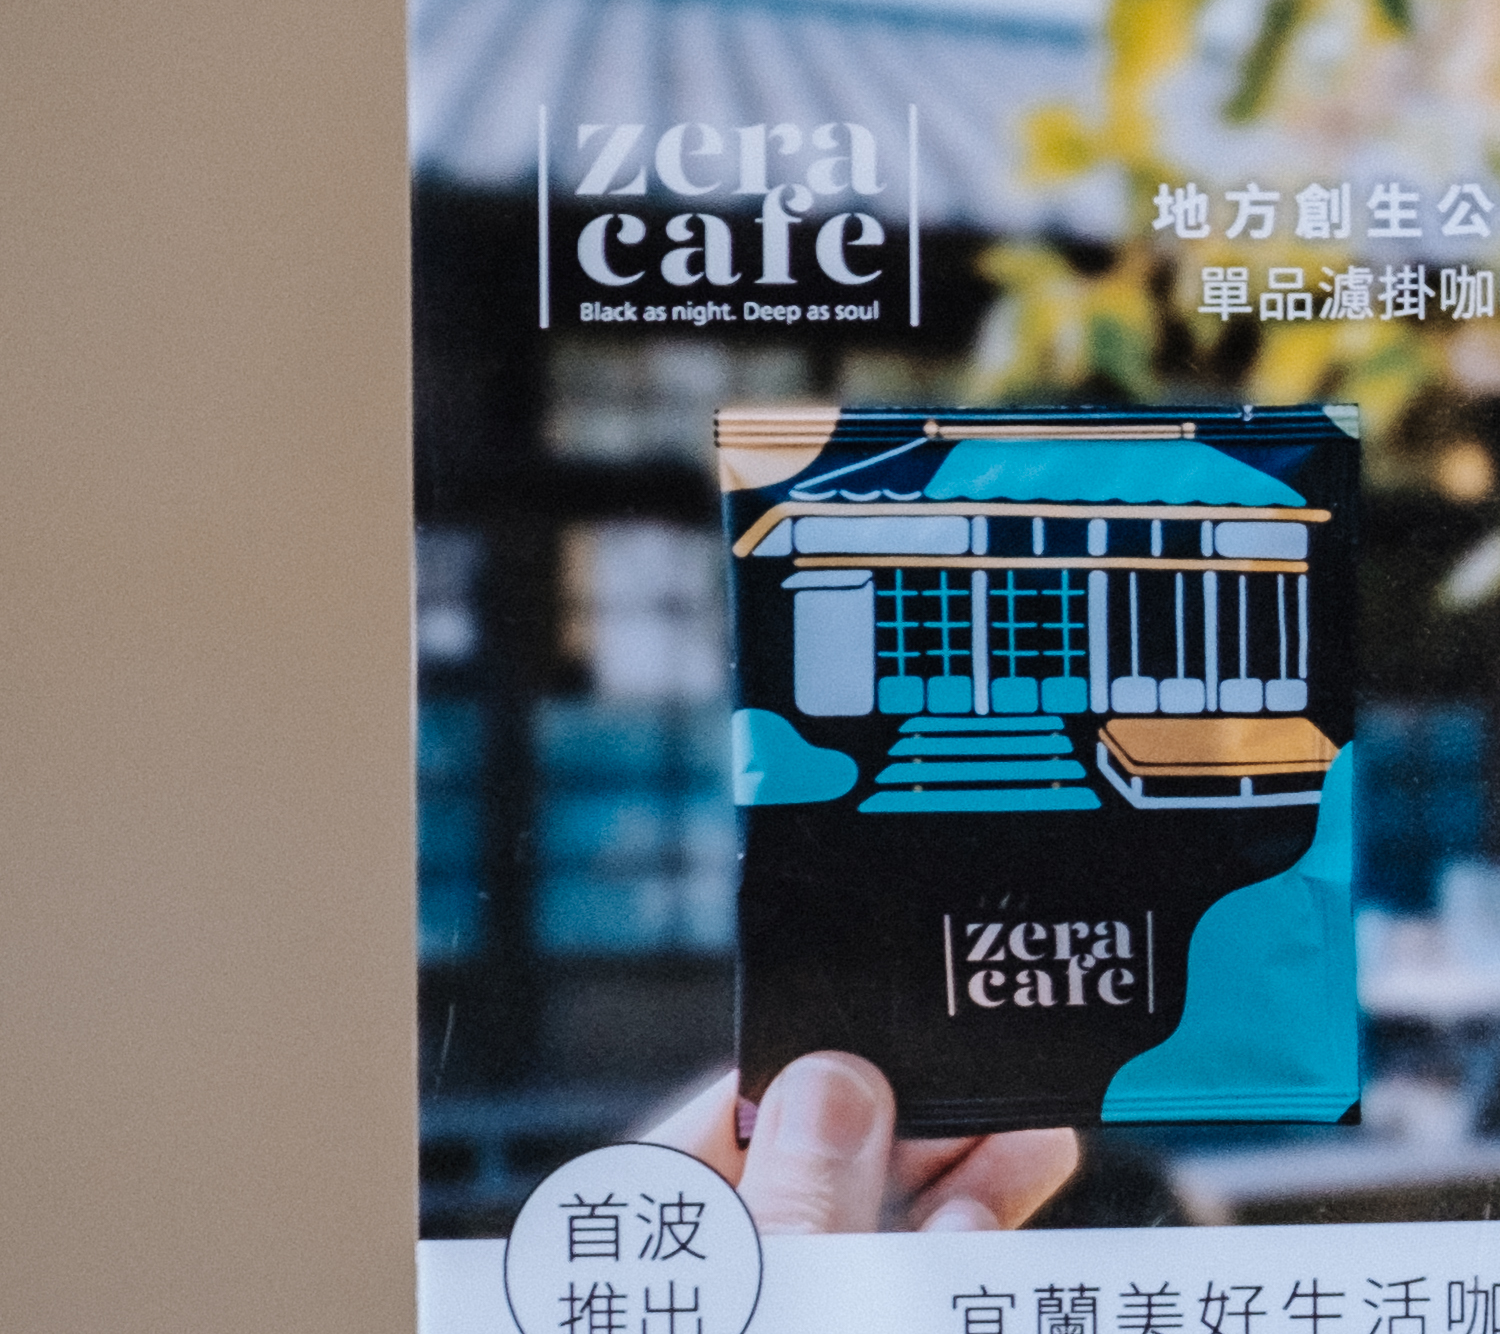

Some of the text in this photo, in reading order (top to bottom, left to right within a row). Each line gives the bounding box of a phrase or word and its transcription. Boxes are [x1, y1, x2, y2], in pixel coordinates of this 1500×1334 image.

[574, 122, 888, 196] zera
[576, 183, 886, 287] cafe
[579, 300, 880, 327] Black as night. Deep as soul
[965, 918, 1135, 964] zera
[965, 952, 1137, 1009] cafe
[559, 1191, 709, 1265] 首波
